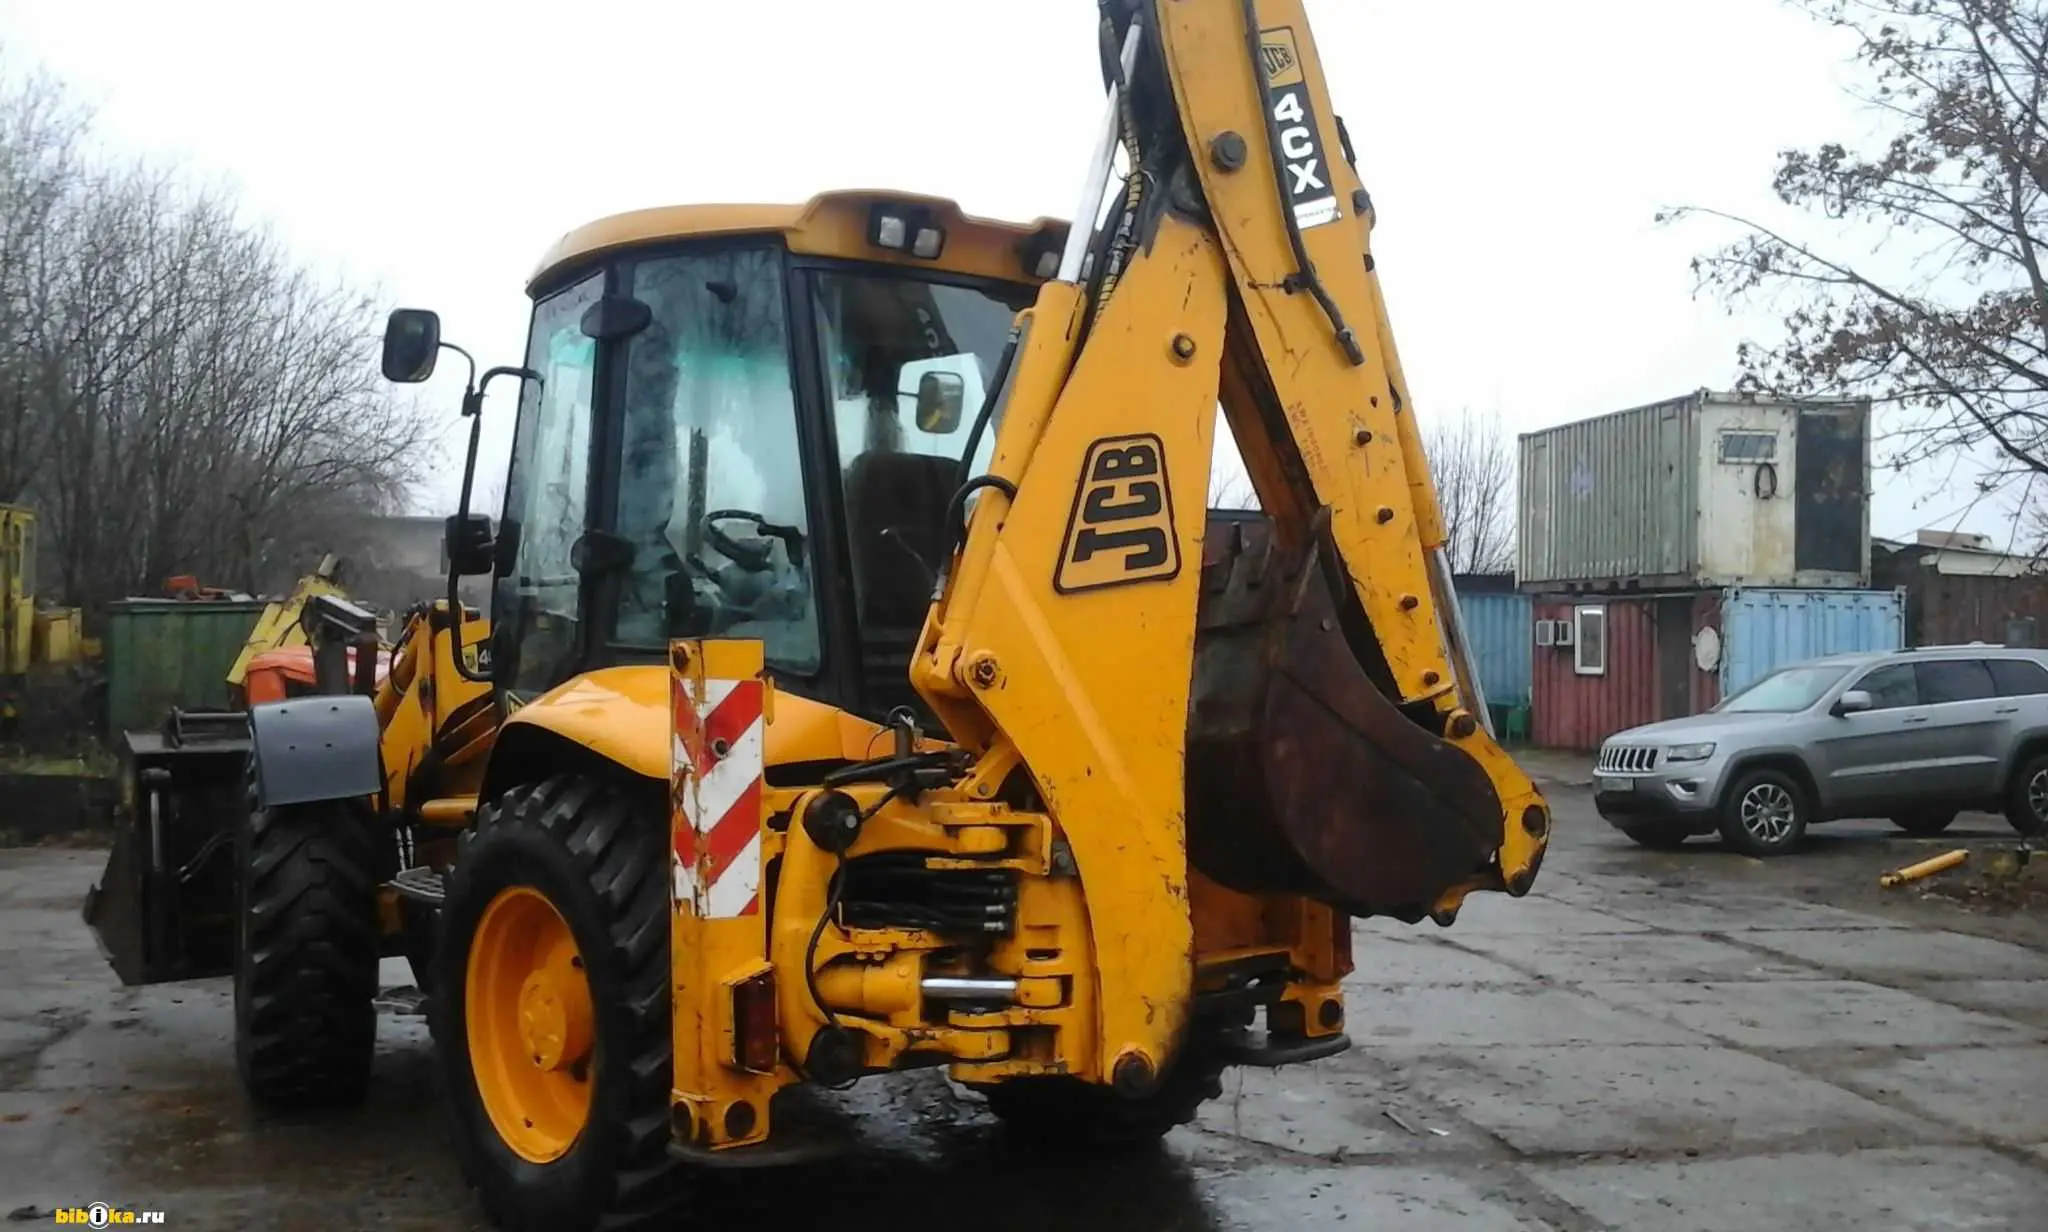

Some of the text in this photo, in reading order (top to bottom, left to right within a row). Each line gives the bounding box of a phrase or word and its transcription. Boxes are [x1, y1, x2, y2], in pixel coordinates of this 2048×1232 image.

[1263, 46, 1293, 74] JCB
[1273, 92, 1325, 194] 4CX
[1071, 444, 1168, 571] JCB
